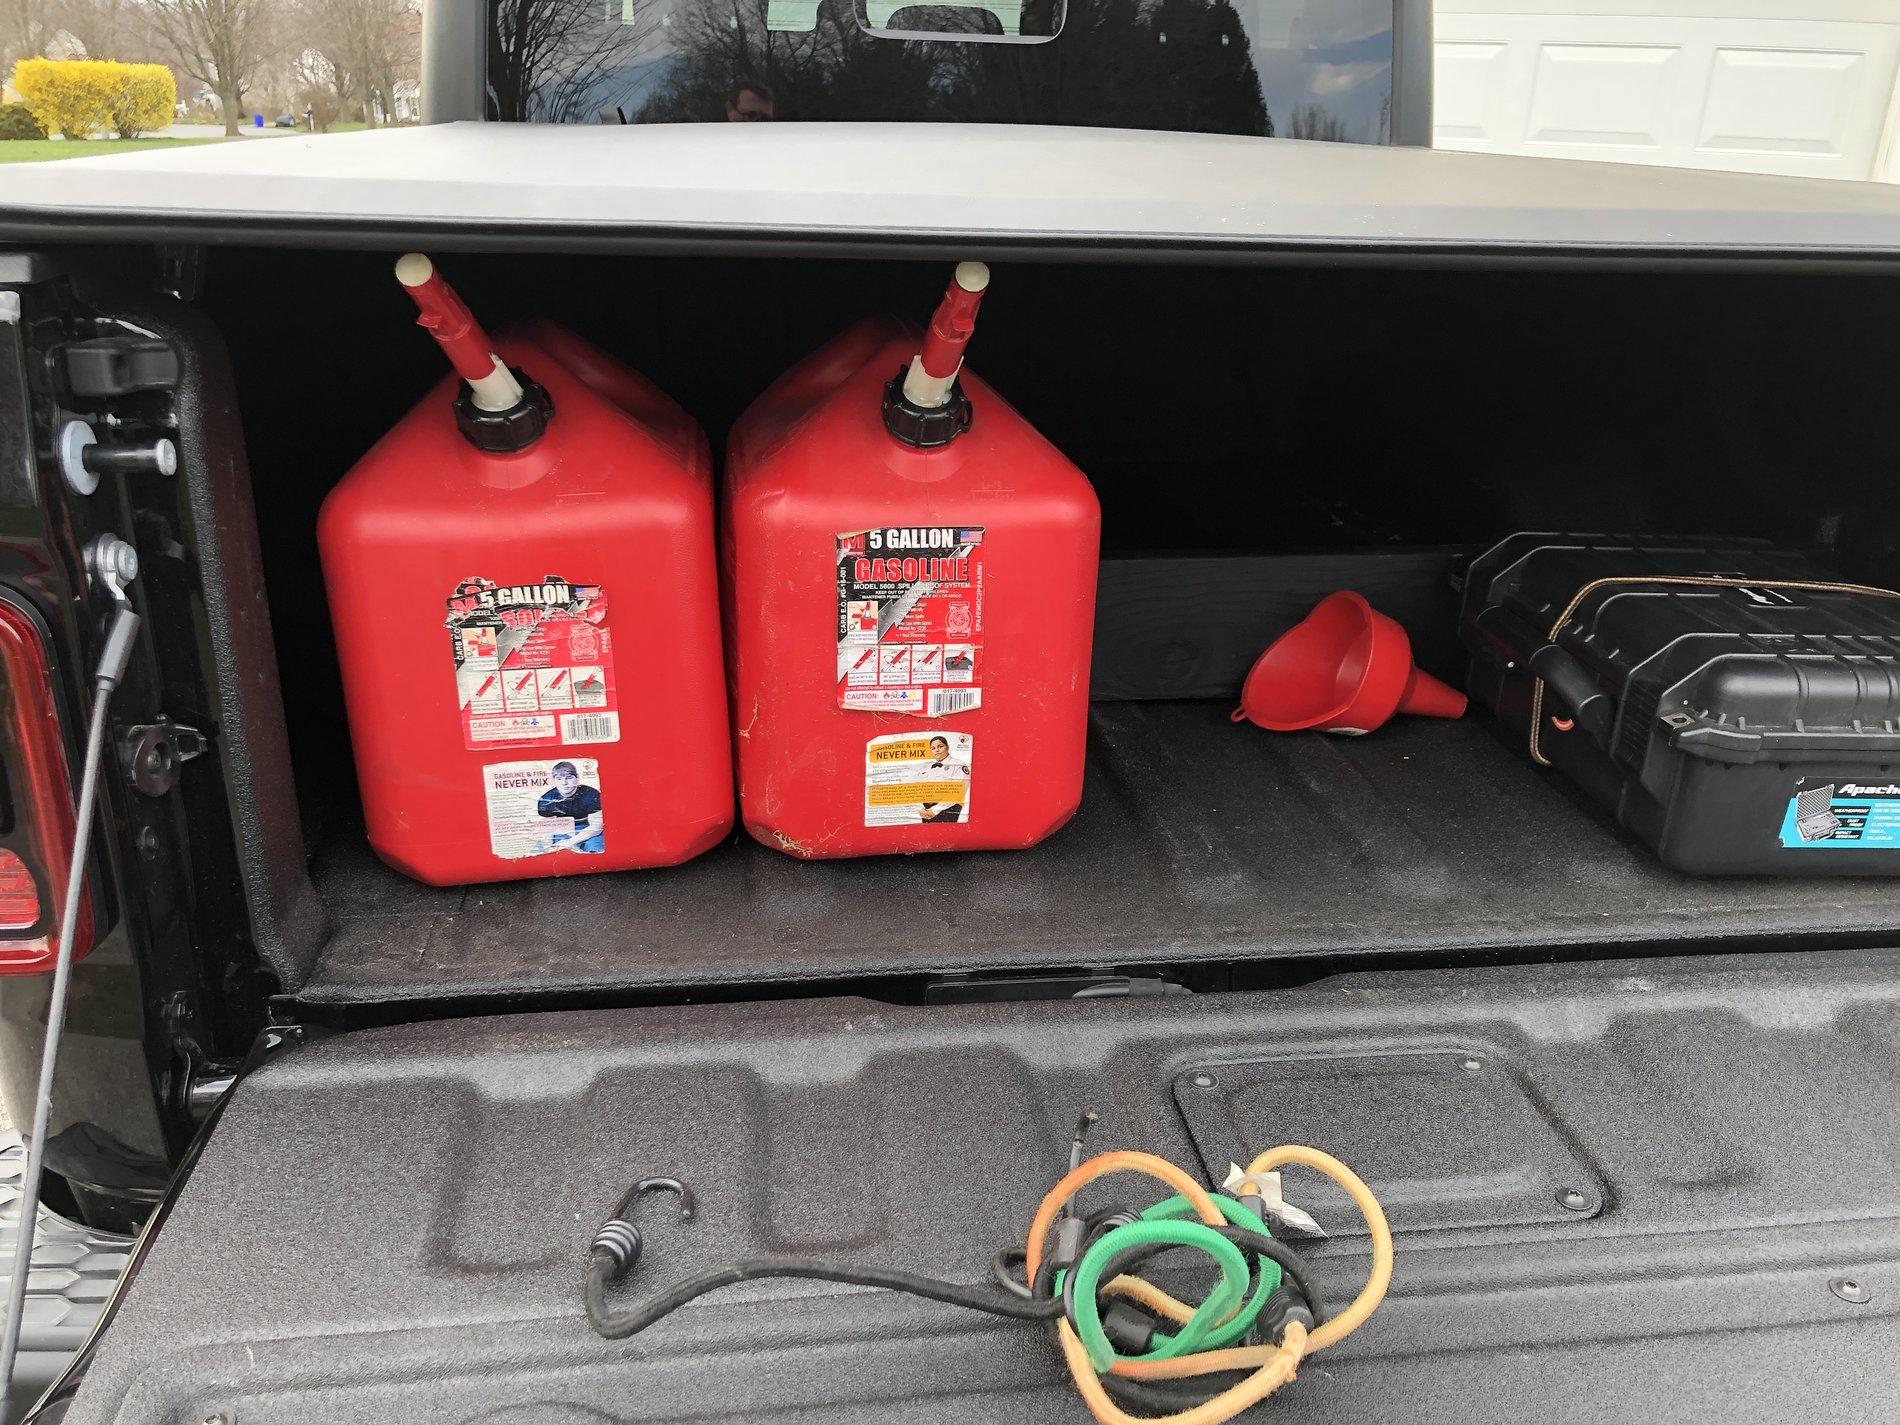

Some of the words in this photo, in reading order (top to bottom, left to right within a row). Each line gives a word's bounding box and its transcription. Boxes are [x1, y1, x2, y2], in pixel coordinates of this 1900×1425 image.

[870, 529, 882, 549] 5
[886, 529, 954, 549] GALLON
[854, 557, 969, 582] GASOLINE
[479, 591, 496, 608] 5
[497, 584, 570, 606] GALLON
[876, 751, 907, 760] NEVER
[909, 749, 926, 758] MIX
[494, 771, 525, 780] GASOLINE
[495, 778, 528, 789] NEVER
[531, 777, 549, 787] MIX
[1838, 783, 1900, 796] Apach
